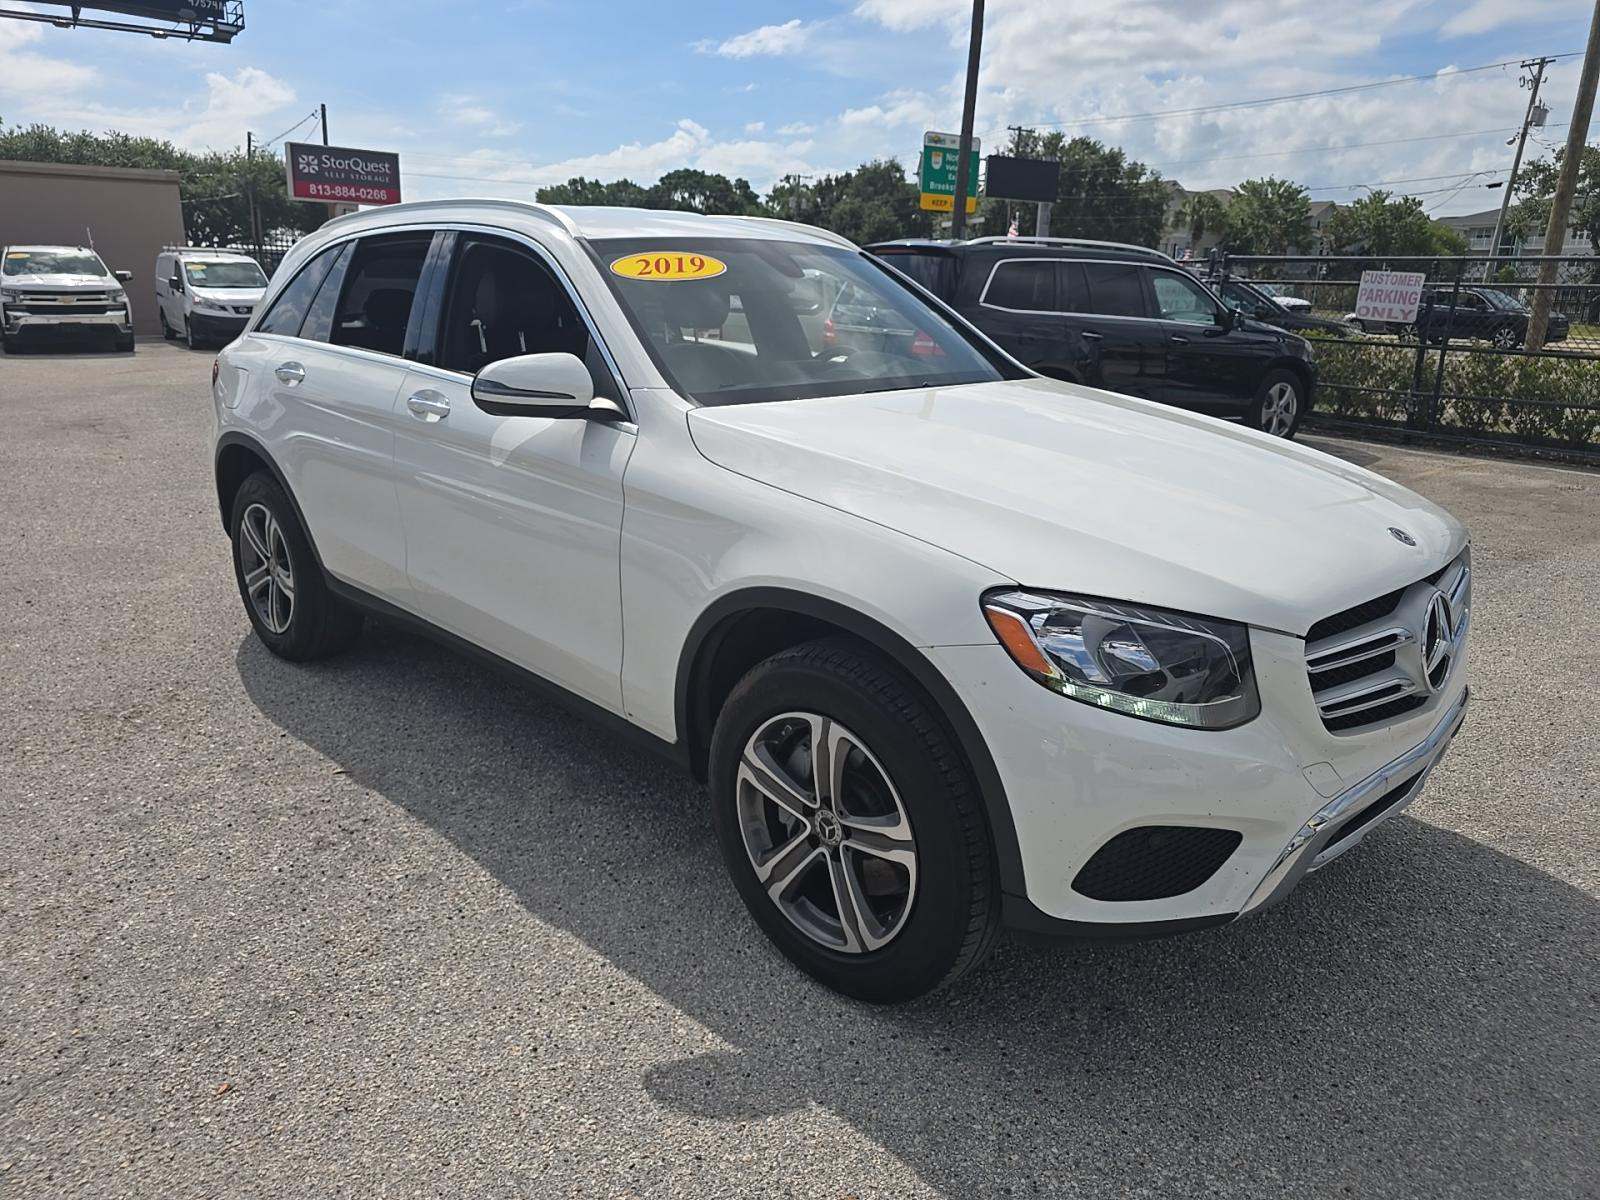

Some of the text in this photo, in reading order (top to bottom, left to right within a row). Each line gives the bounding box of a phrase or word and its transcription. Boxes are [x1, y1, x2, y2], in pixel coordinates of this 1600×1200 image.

[321, 155, 391, 174] StorQuest
[350, 174, 389, 183] STORAGE
[309, 183, 387, 200] 813-884-0266
[636, 257, 705, 275] 2019
[1363, 272, 1422, 287] CUSTOMER
[1359, 288, 1418, 305] PARKING
[1357, 306, 1415, 320] ONLY
